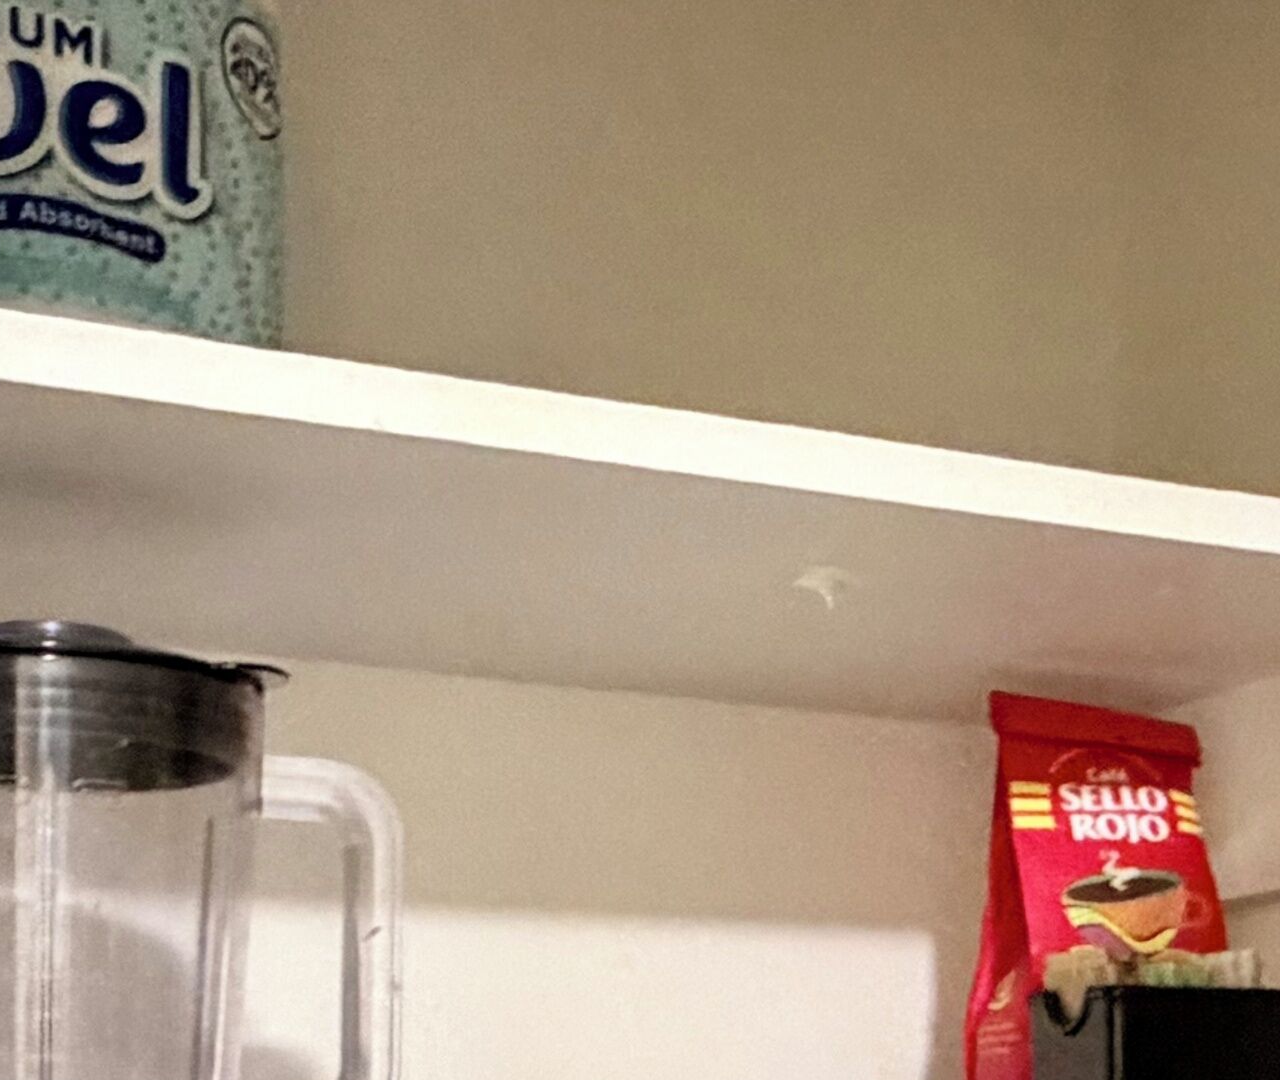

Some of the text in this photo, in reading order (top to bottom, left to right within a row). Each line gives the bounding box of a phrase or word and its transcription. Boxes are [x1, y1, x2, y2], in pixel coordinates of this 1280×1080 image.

[19, 201, 157, 255] Absorbent
[1060, 782, 1168, 813] SELLO
[1070, 813, 1171, 844] ROJO
